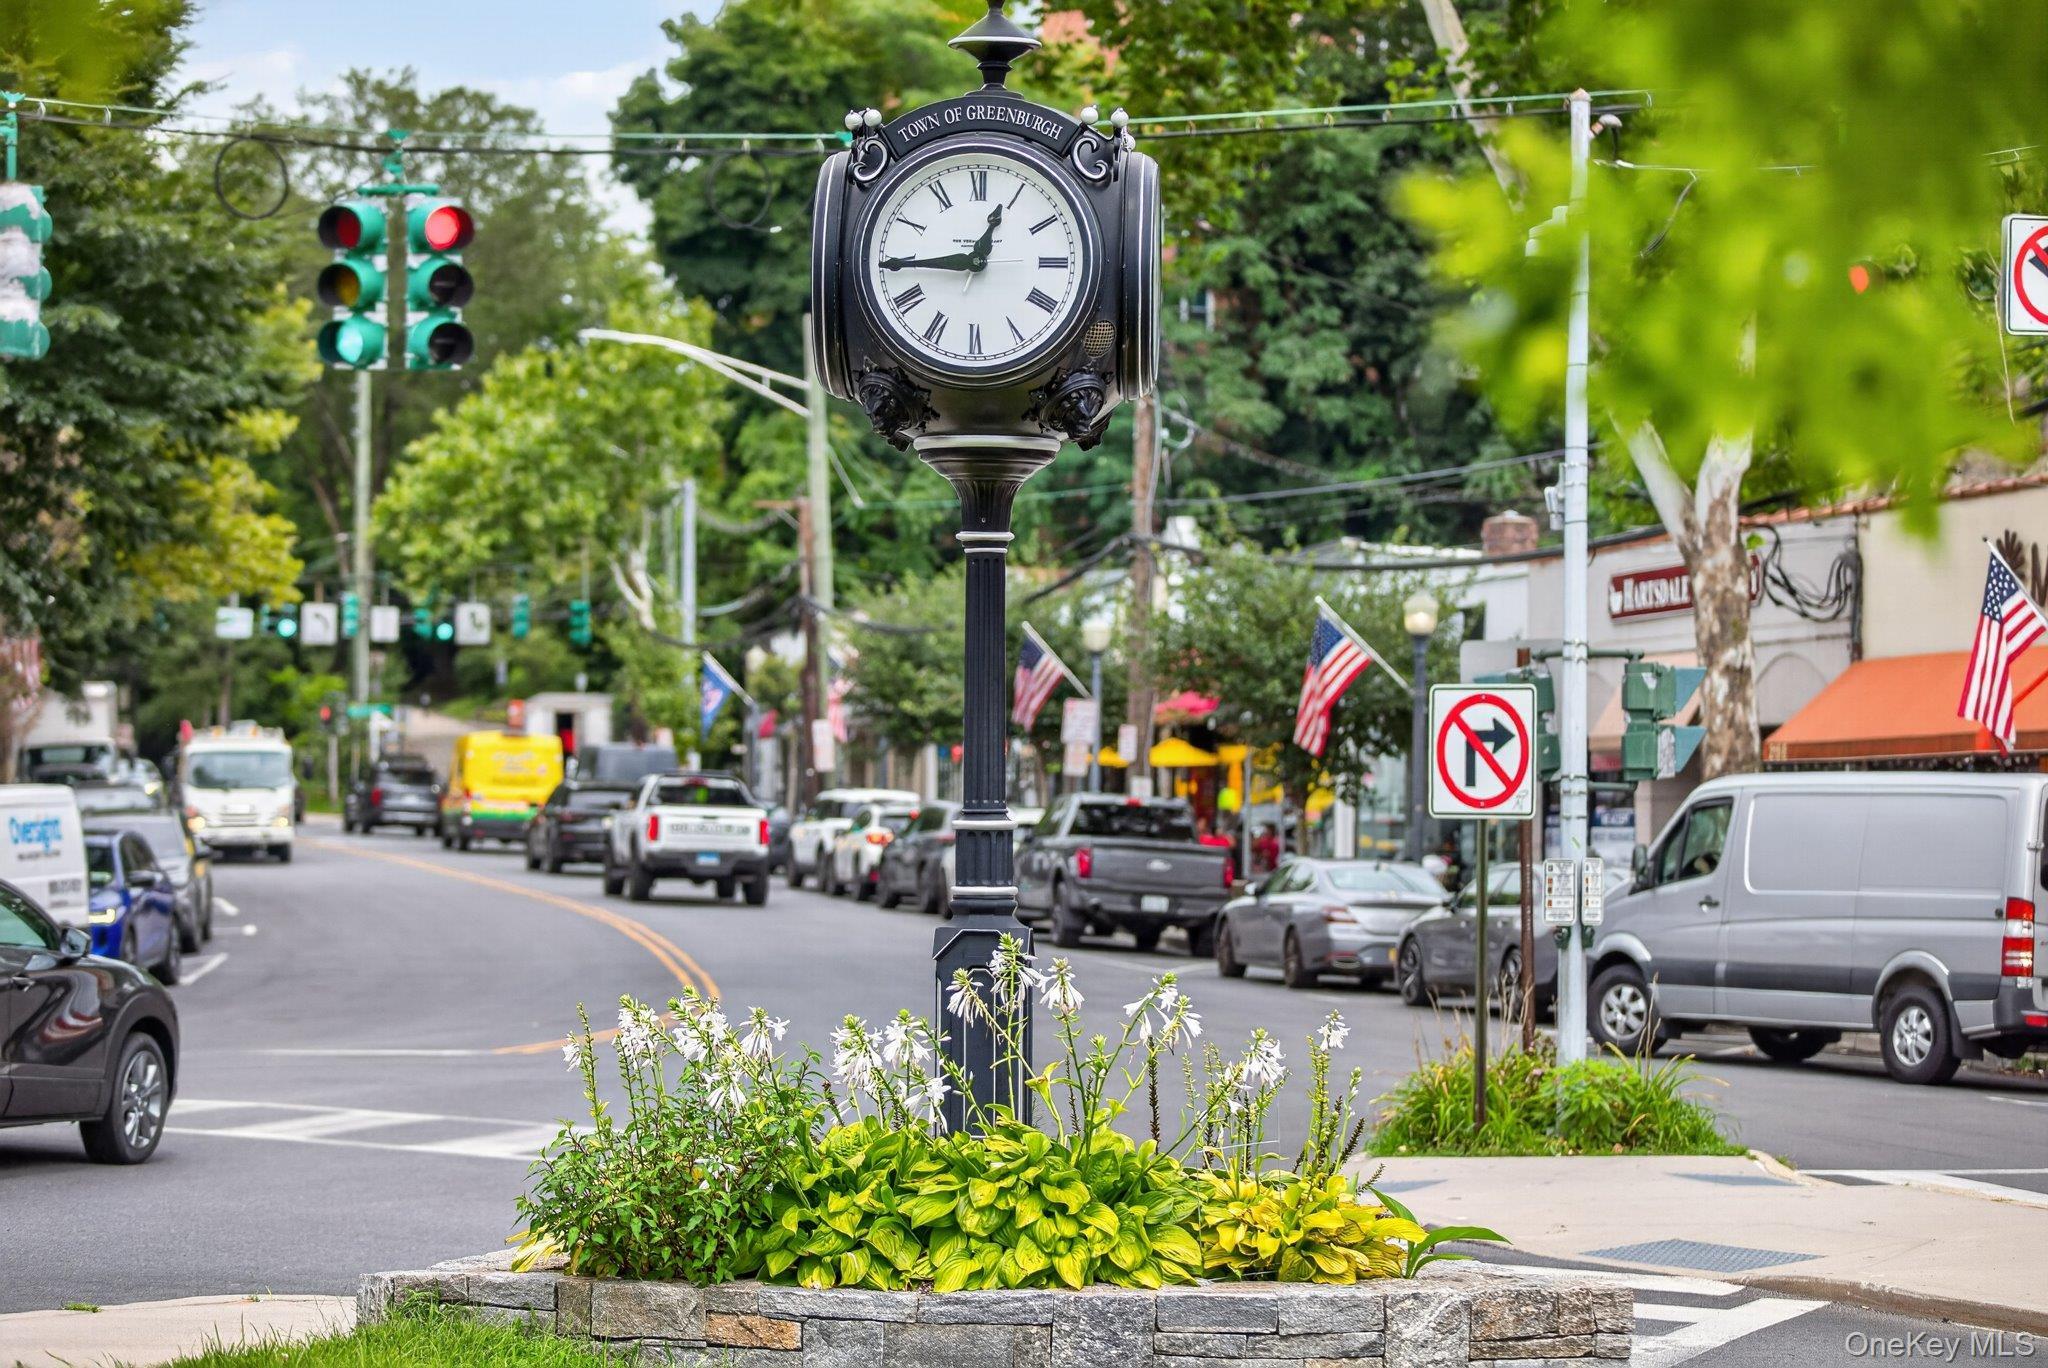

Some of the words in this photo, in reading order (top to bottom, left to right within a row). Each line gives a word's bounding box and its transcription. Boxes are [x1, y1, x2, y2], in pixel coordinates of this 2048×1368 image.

[898, 113, 941, 143] TOWN
[944, 107, 962, 124] OF
[966, 105, 1063, 141] GREENBURGH
[928, 180, 954, 214] XI
[969, 171, 987, 201] XII
[896, 212, 927, 236] X
[1028, 214, 1058, 235] II
[1038, 256, 1069, 269] III
[892, 283, 926, 317] VIII
[922, 310, 949, 345] VII
[968, 323, 984, 354] VI
[1006, 316, 1026, 345] V
